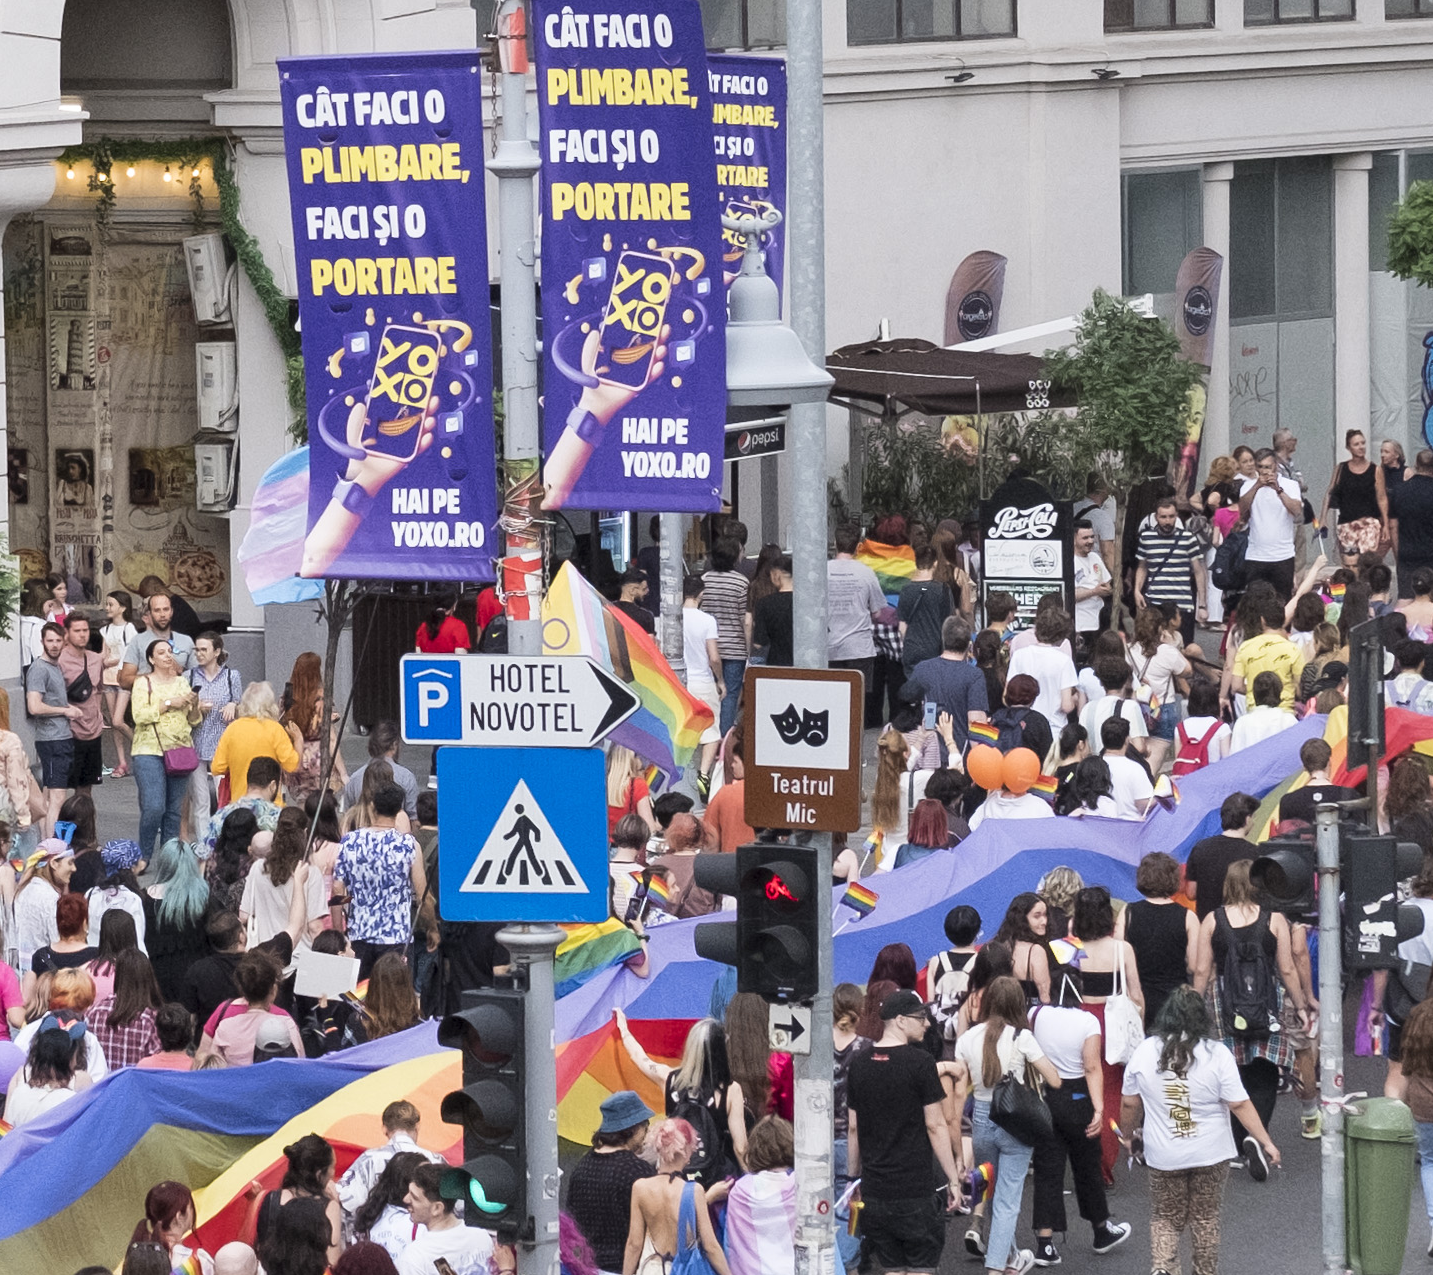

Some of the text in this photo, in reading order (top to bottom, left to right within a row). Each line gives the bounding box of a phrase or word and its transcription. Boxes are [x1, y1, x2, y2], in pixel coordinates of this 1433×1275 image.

[545, 6, 672, 48] CÂT FACI O
[548, 68, 697, 109] PLIMBARE,
[297, 86, 445, 127] CÂT FACI O
[713, 104, 779, 128] IMBARE,
[549, 130, 607, 163] FACI
[640, 129, 659, 163] O
[301, 143, 470, 183] PLIMBARE,
[717, 165, 768, 187] RTARE
[552, 183, 690, 220] PORTARE
[306, 206, 369, 239] FACI
[405, 205, 425, 238] O
[311, 257, 456, 295] PORTARE
[622, 418, 688, 444] HAI PE
[752, 428, 779, 449] pepsi
[621, 451, 710, 478] YOXO.RO
[392, 488, 460, 514] HAI PE
[392, 522, 484, 547] YOXO.RO
[490, 663, 571, 695] HOTEL
[469, 701, 584, 733] NOVOTEL
[771, 772, 834, 797] Teatrul
[785, 802, 818, 825] Mic
